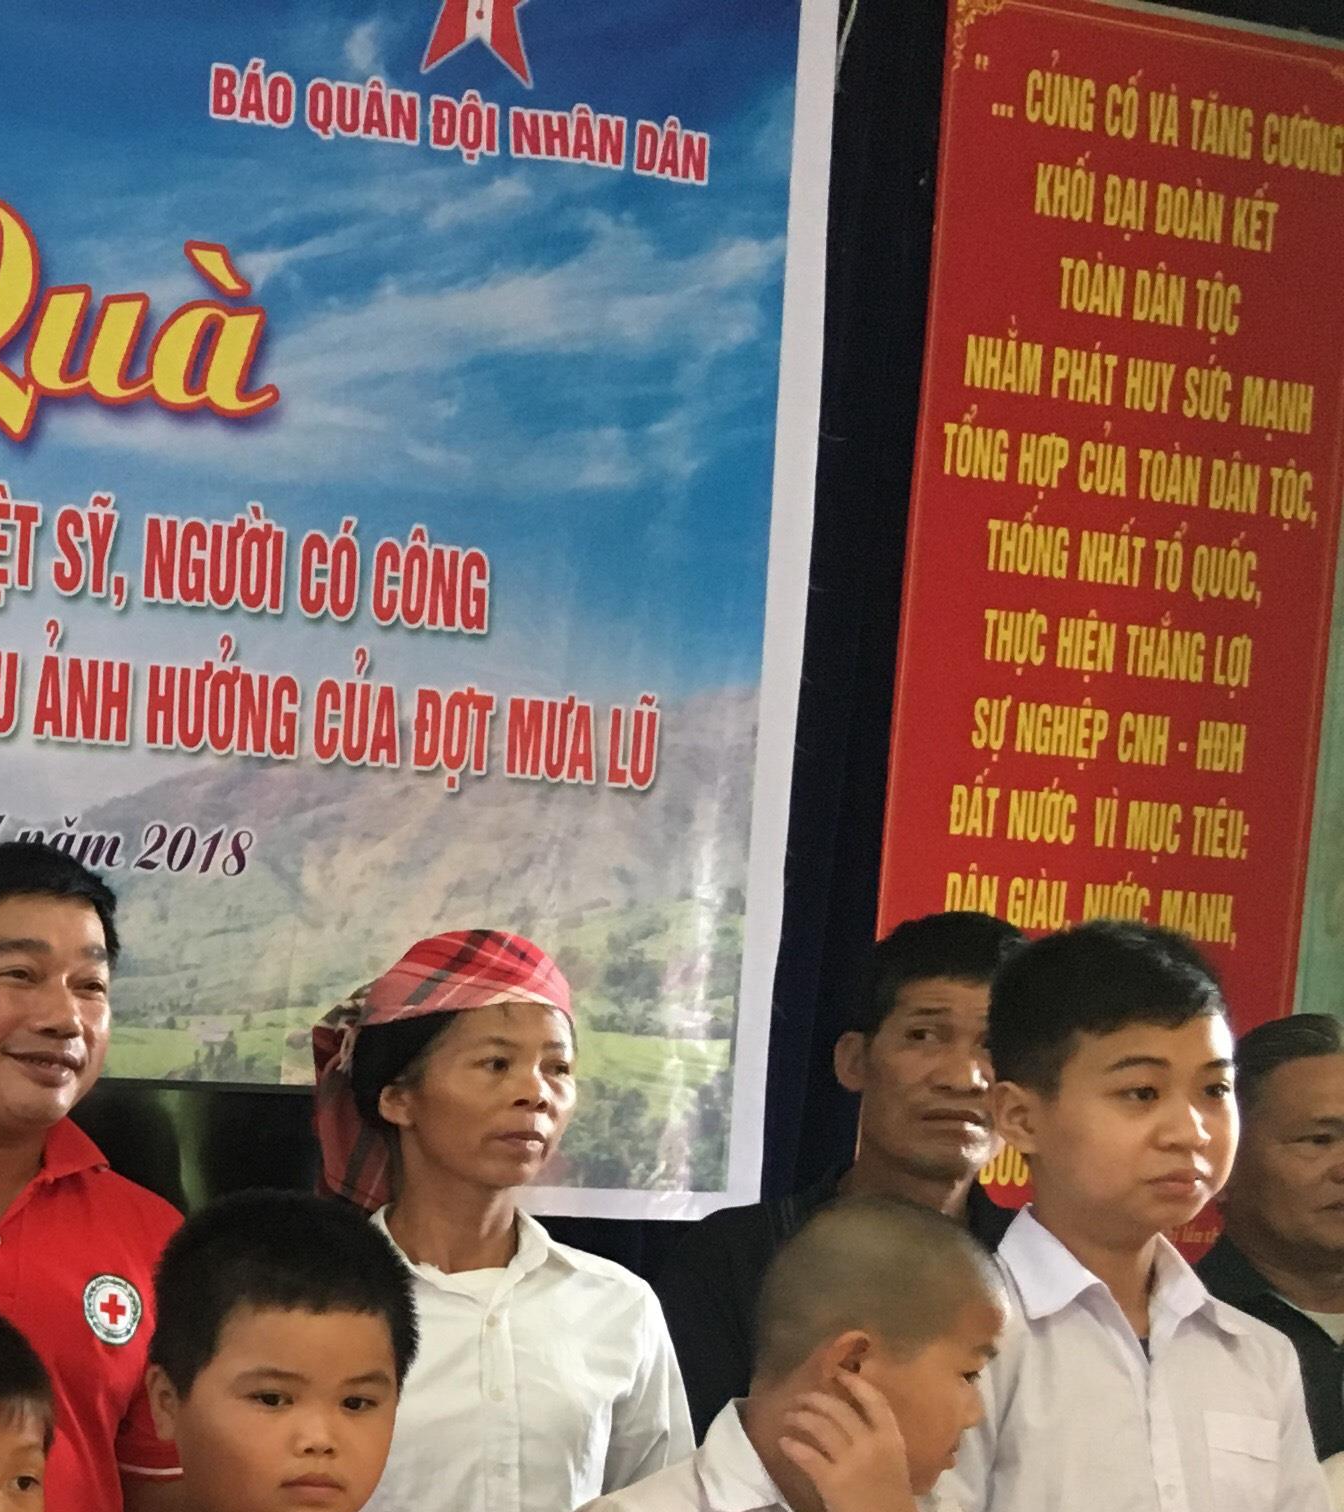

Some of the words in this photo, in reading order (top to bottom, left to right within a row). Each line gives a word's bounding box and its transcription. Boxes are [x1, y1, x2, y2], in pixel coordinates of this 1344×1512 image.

[213, 64, 292, 123] BÁO
[309, 82, 416, 140] QUÂN
[433, 96, 495, 159] ĐỘI
[513, 109, 623, 165] NHÂN
[637, 125, 706, 180] DÂN
[1026, 50, 1096, 131] CỦNG
[1105, 70, 1139, 139] CỐ
[1149, 83, 1179, 145] VÀ
[1190, 92, 1254, 160] TĂNG
[1262, 106, 1343, 176] CƯỜNG
[1035, 151, 1095, 222] KHỐI
[1104, 174, 1147, 241] ĐẠI
[1155, 178, 1225, 242] ĐOÀN
[1232, 182, 1279, 252] KẾT
[1061, 252, 1125, 317] TOÀN
[1133, 262, 1186, 326] DÂN
[1196, 272, 1242, 344] TỘC
[964, 315, 1043, 395] NHẰM
[1051, 342, 1118, 405] PHÁT
[1125, 358, 1176, 413] HUY
[1182, 355, 1232, 422] SỨC
[1240, 376, 1314, 441] MẠNH
[944, 405, 1009, 481] TỔNG
[1018, 433, 1069, 499] HỢP
[1078, 421, 1126, 496] CỦA
[1139, 442, 1202, 506] TOÀN
[1209, 451, 1260, 514] DÂN
[1270, 459, 1317, 530] TỘC,
[54, 497, 124, 605] SỸ,
[144, 507, 283, 608] NGƯỜI
[301, 522, 356, 616] CÓ
[373, 529, 486, 629] CÔNG
[988, 505, 1069, 579] THỐNG
[1078, 517, 1146, 587] NHẤT
[1155, 521, 1183, 592] TỔ
[1192, 532, 1262, 608] QUỐC,
[34, 621, 129, 741] ẢNH
[147, 636, 297, 755] HƯỞNG
[314, 649, 396, 763] CỦA
[414, 688, 493, 788] ĐỢT
[507, 697, 592, 780] MƯA
[608, 696, 656, 786] LŨ
[985, 609, 1047, 675] THỰC
[1056, 610, 1116, 682] HIỆN
[1127, 611, 1206, 682] THẮNG
[1213, 634, 1252, 699] LỢI
[972, 696, 1012, 762] SỰ
[1015, 698, 1109, 770] NGHIỆP
[1118, 712, 1169, 766] CNH
[1196, 720, 1246, 773] HĐH
[135, 825, 252, 876] 2018
[949, 768, 1000, 837] ĐẤT
[1007, 778, 1077, 844] NƯỚC
[1095, 788, 1118, 848] VÌ
[1126, 801, 1182, 864] MỤC
[1192, 798, 1249, 859] TIÊU:
[944, 863, 998, 917] DÂN
